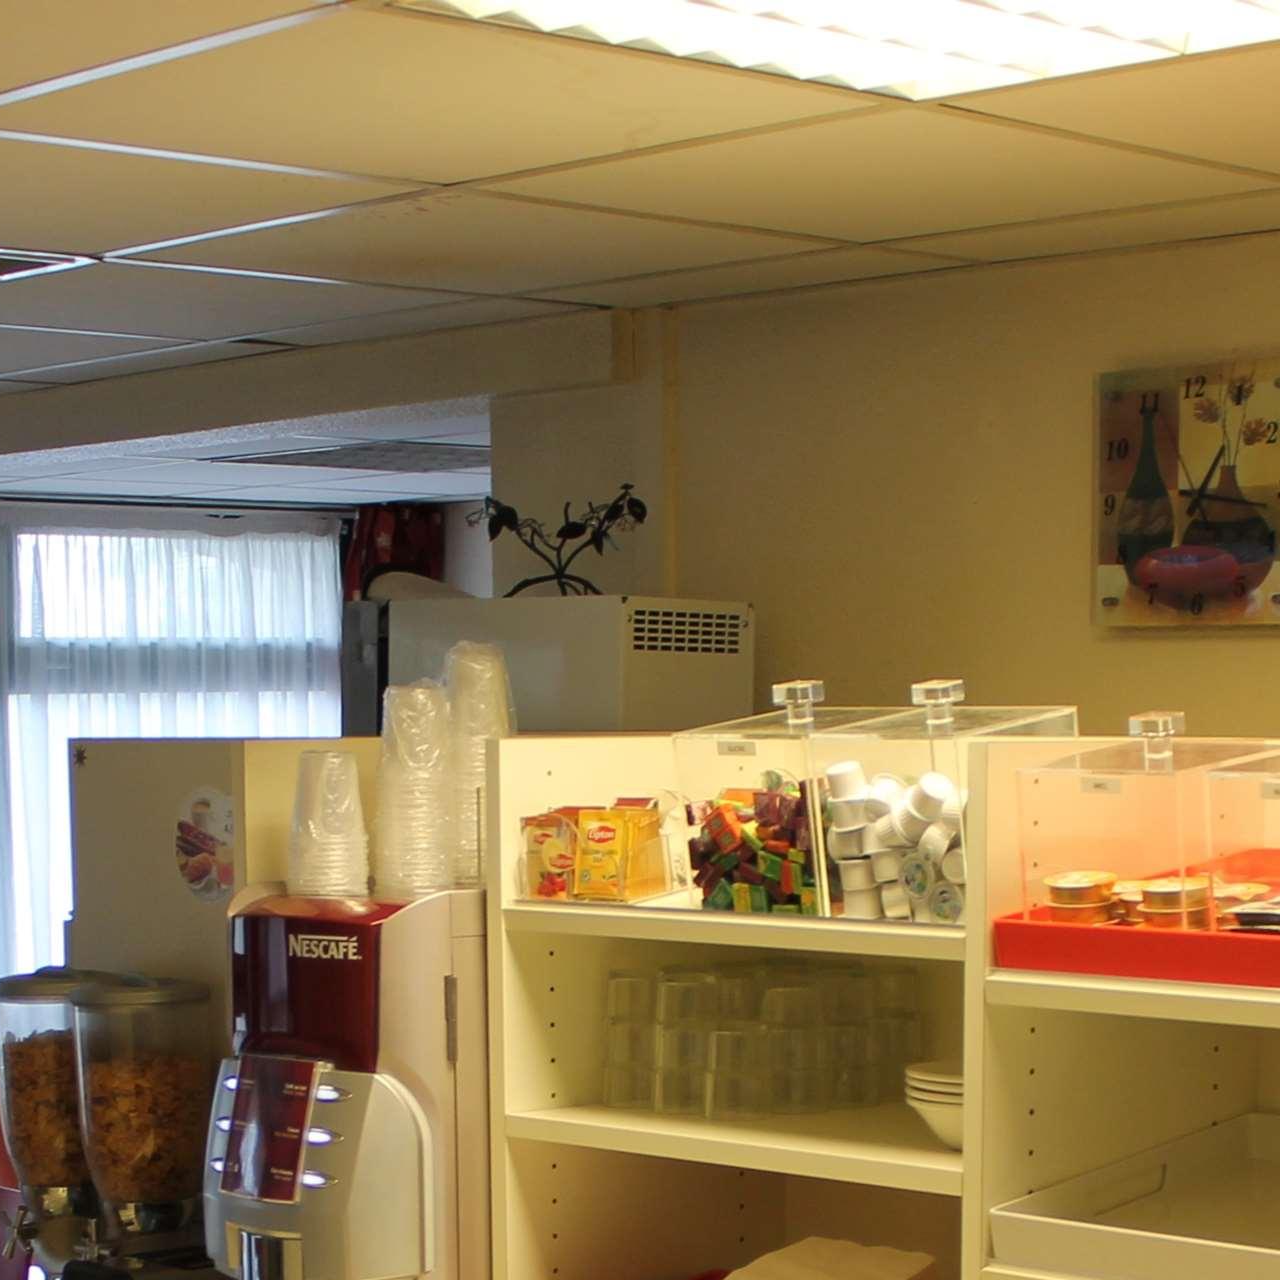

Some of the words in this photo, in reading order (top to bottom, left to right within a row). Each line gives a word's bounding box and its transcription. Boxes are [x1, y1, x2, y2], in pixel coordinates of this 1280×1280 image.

[1183, 375, 1207, 400] 12
[1138, 393, 1160, 416] 11
[1265, 421, 1279, 445] 2
[1106, 438, 1129, 462] 10
[1104, 494, 1116, 517] 9
[1146, 582, 1159, 605] 7
